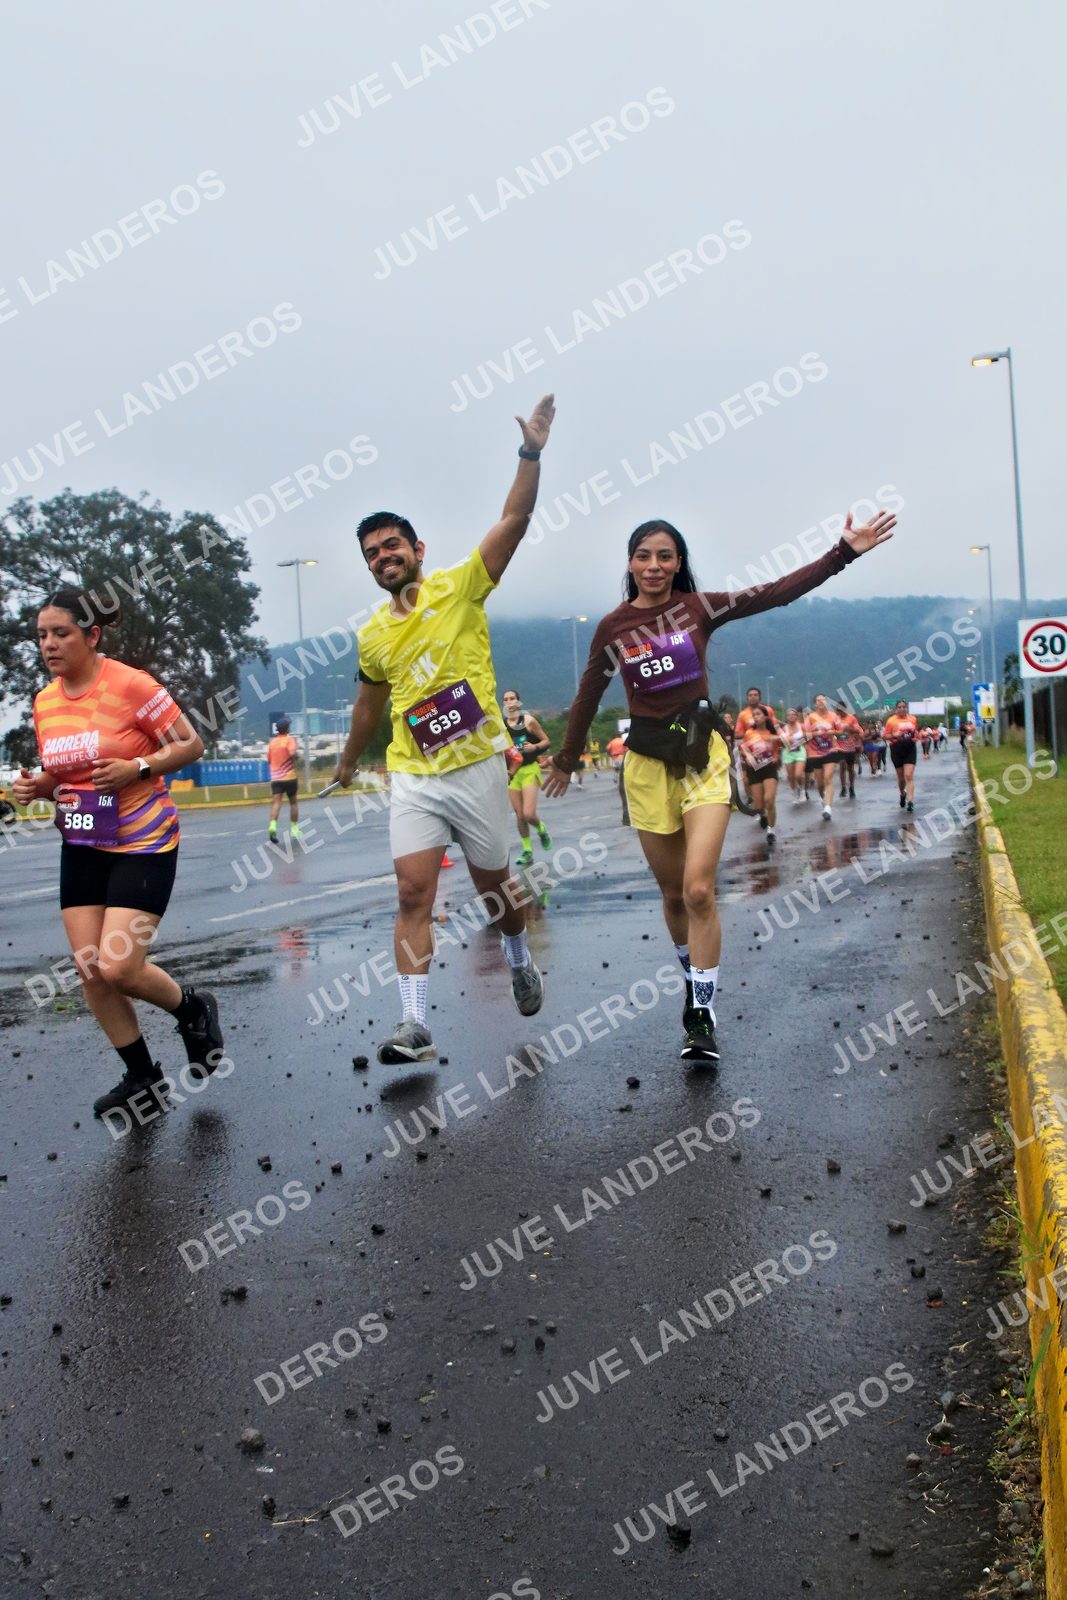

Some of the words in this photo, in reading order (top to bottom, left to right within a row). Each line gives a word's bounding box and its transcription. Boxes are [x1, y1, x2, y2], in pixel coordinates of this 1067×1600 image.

[670, 633, 685, 646] 15K
[1032, 634, 1066, 656] 30
[640, 655, 675, 678] 638
[452, 685, 467, 699] 15K
[429, 709, 462, 735] 639
[42, 730, 99, 755] CARRERA
[98, 795, 114, 807] 15K
[64, 813, 95, 831] 588
